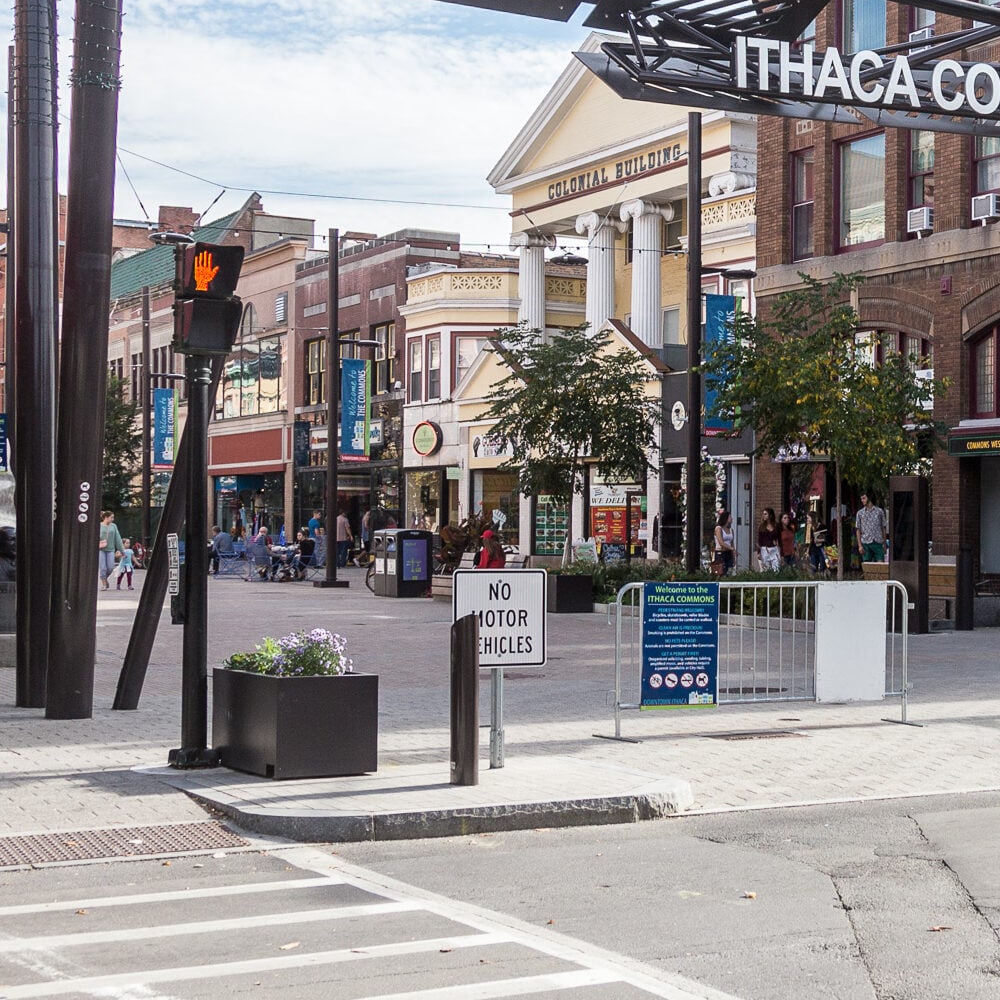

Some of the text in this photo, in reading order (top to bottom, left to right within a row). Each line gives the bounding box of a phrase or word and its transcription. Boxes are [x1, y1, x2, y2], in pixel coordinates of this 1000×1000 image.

[735, 36, 921, 108] ITHACA
[548, 144, 681, 200] COLONIAL BUILDING
[348, 380, 357, 416] Welcome
[357, 370, 366, 417] THE COMMONS
[966, 440, 990, 450] COMMONS
[489, 582, 511, 601] NO
[647, 595, 715, 603] ITHACA COMMONS
[655, 585, 687, 593] Welcome
[696, 585, 709, 593] the
[479, 635, 533, 655] EHICLES
